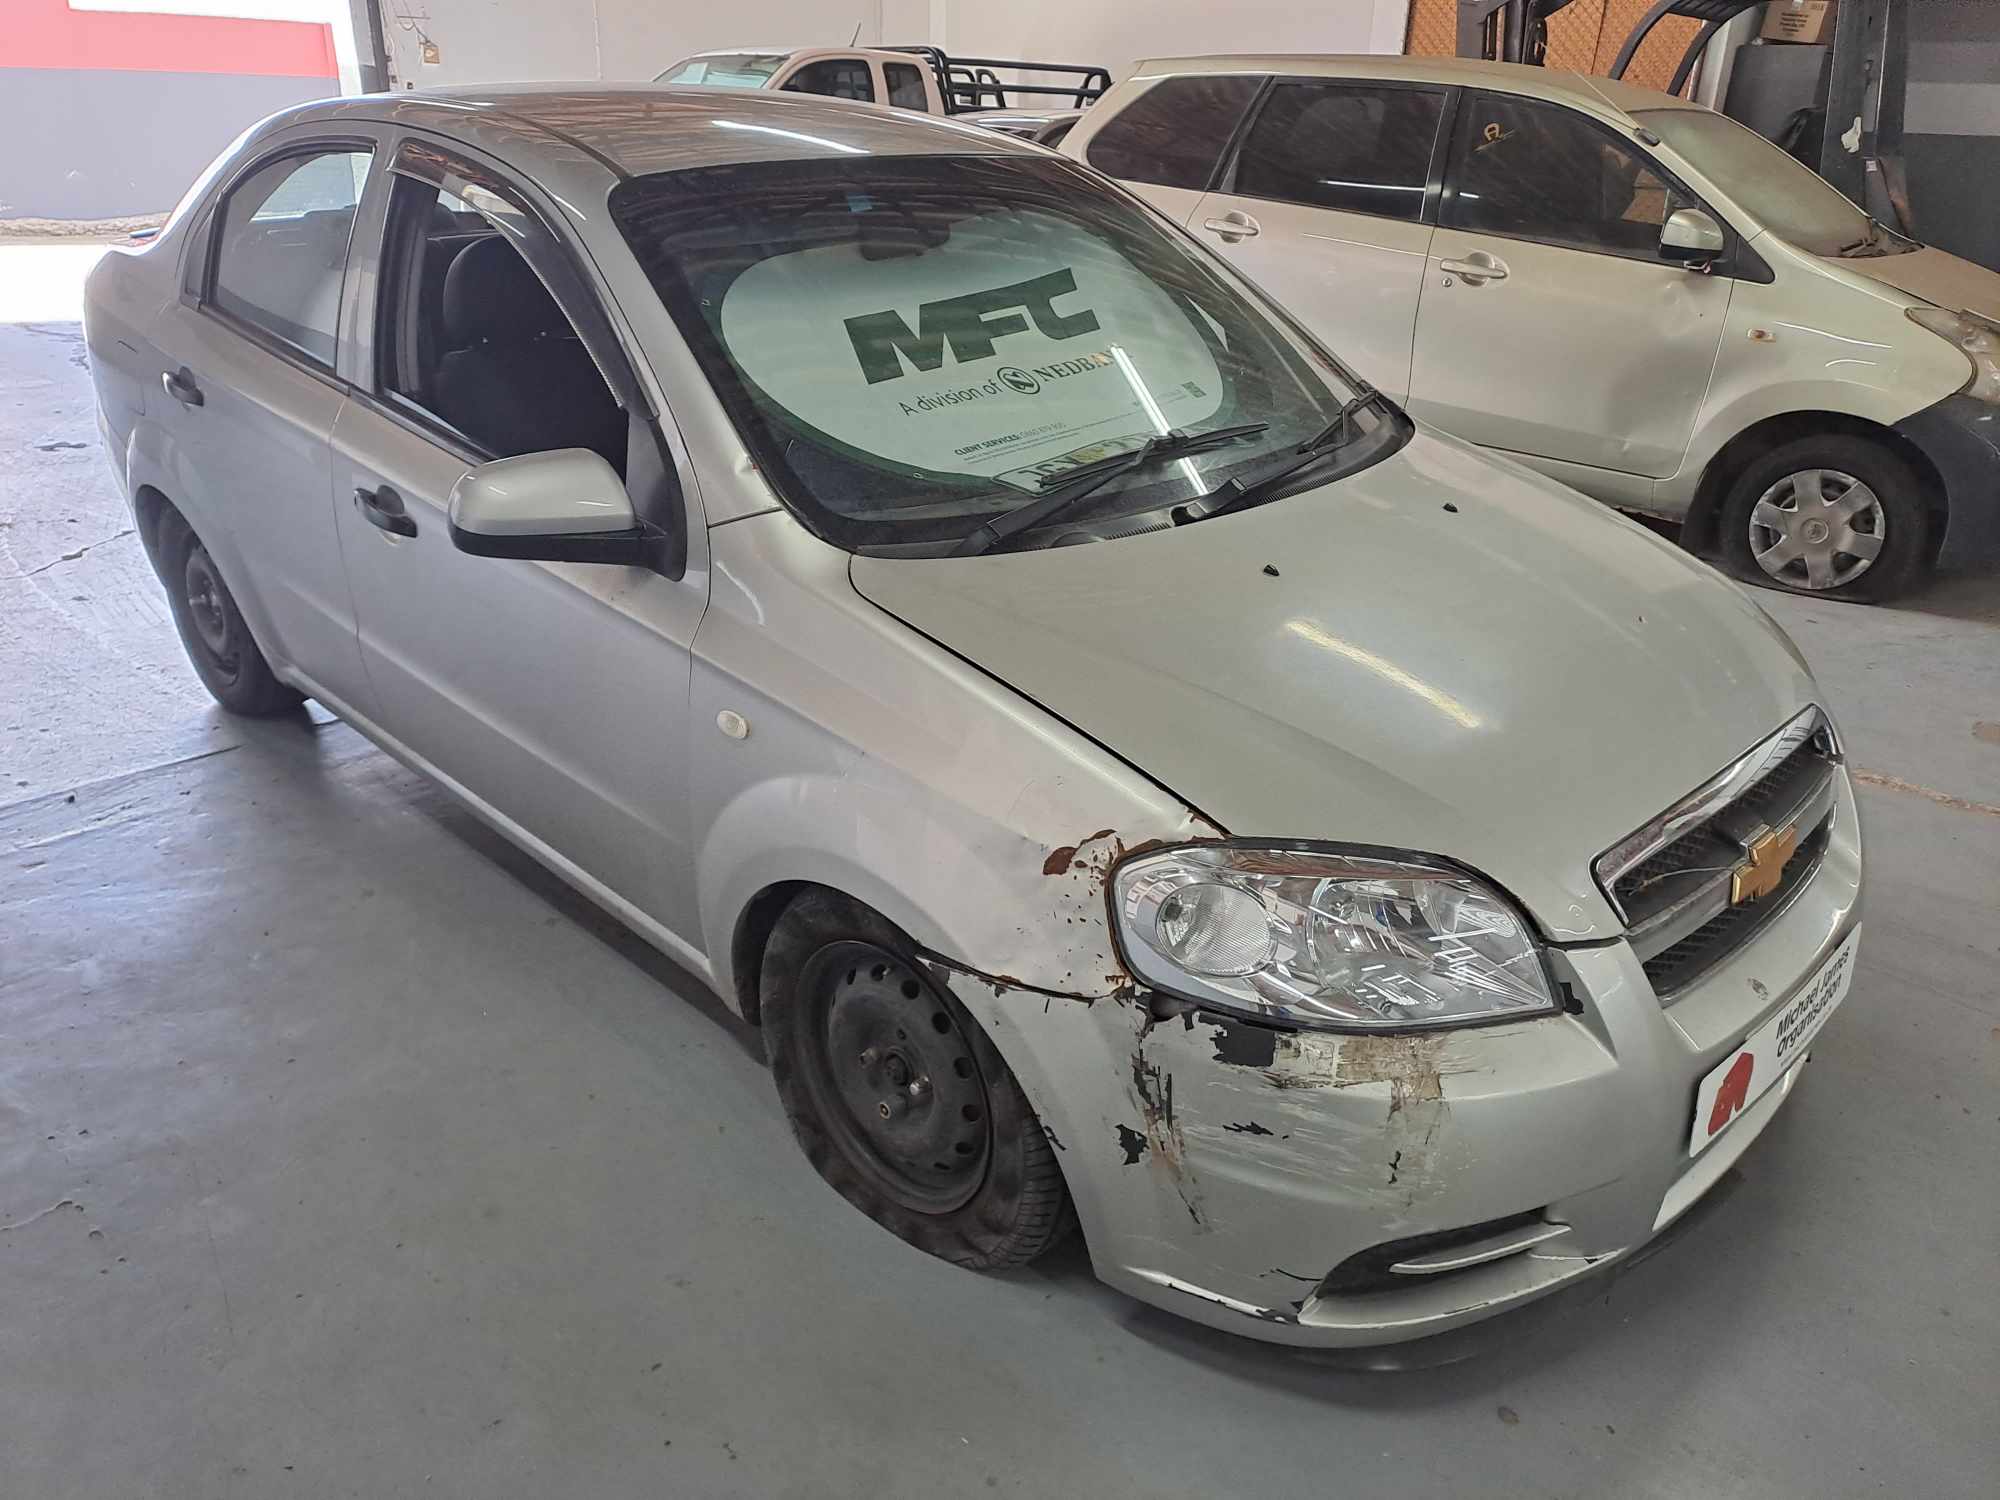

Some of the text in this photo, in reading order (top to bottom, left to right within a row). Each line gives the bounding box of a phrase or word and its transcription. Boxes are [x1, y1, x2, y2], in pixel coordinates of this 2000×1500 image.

[844, 267, 1101, 385] MFC
[898, 401, 919, 417] A
[917, 386, 984, 411] division
[983, 378, 1003, 396] of
[954, 443, 983, 456] CLIENT
[1776, 980, 1820, 1040] Michael
